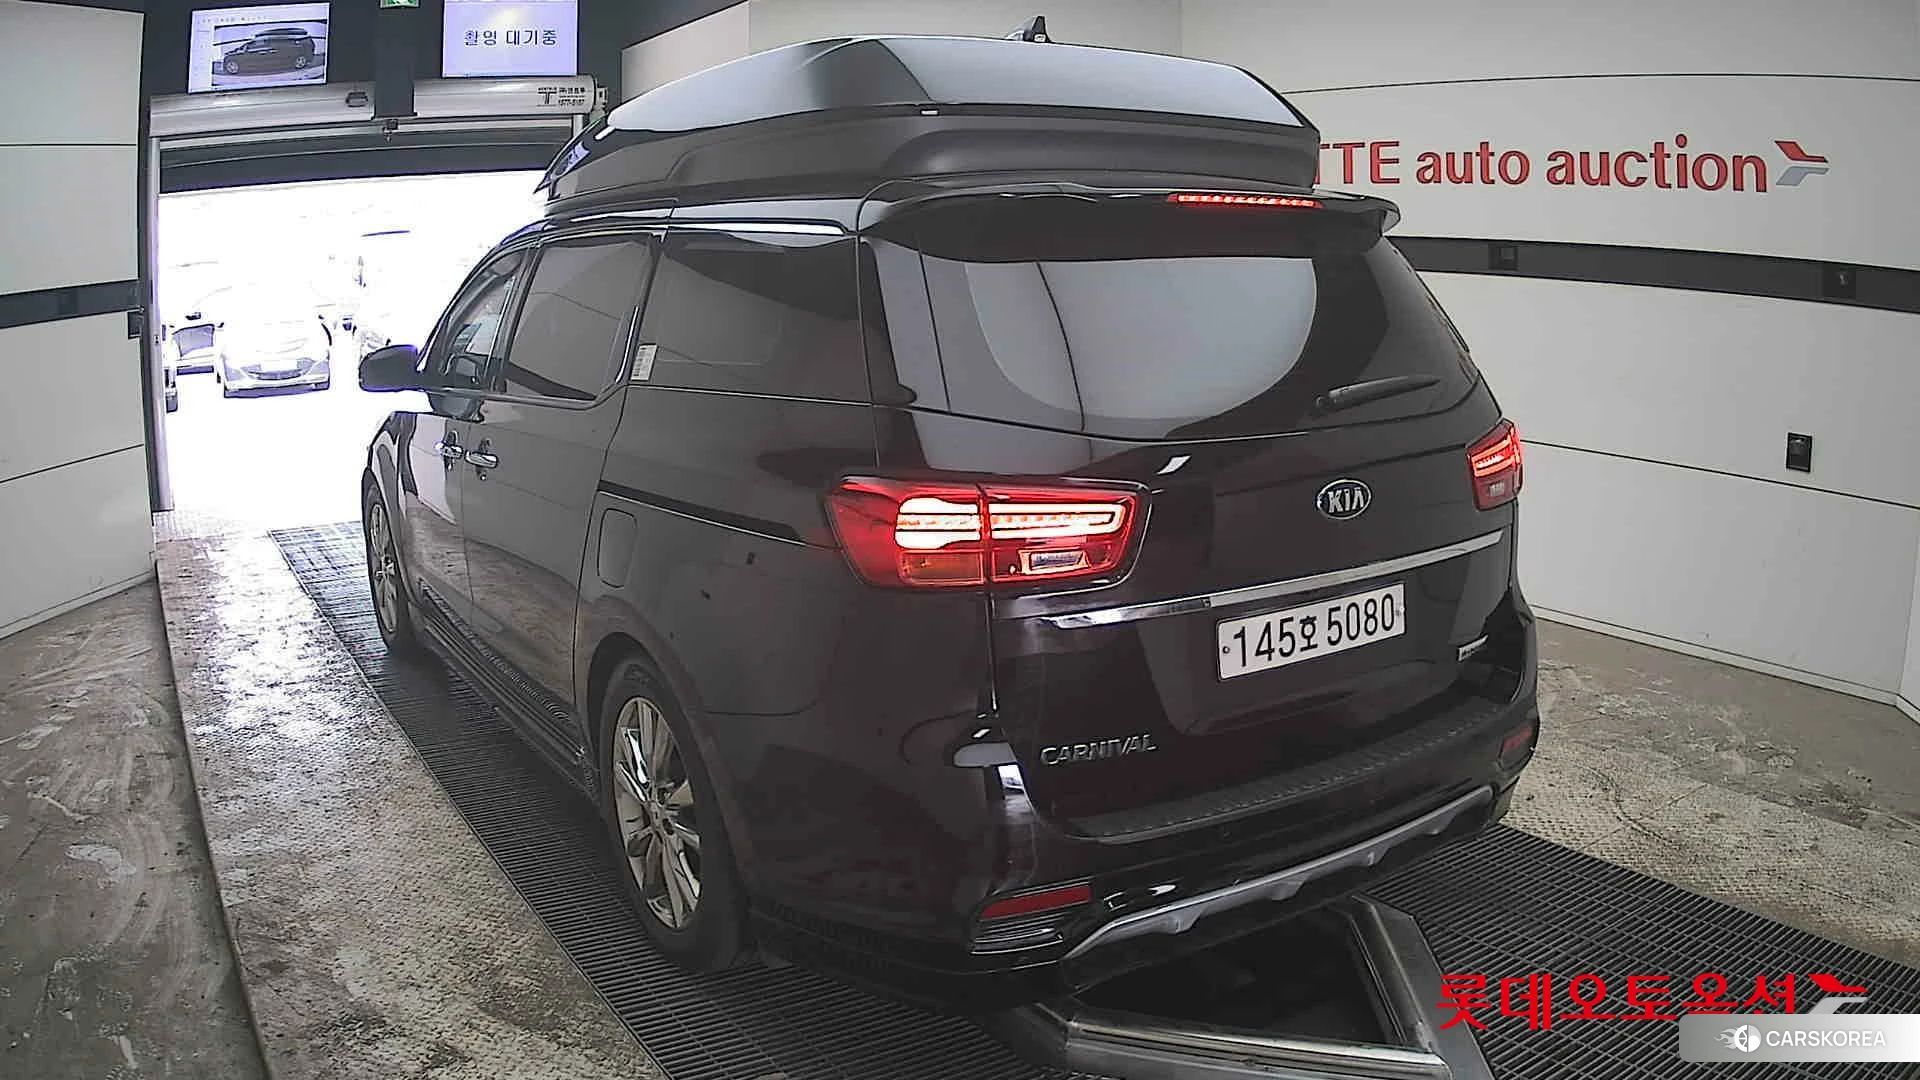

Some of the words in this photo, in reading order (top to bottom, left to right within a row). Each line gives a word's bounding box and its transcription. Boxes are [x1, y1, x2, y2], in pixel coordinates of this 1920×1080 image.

[505, 29, 557, 46] 대기중
[1415, 141, 1530, 185] auto
[1546, 134, 1768, 193] auction
[1326, 486, 1365, 513] KIA
[1041, 734, 1157, 765] CARNIVAL
